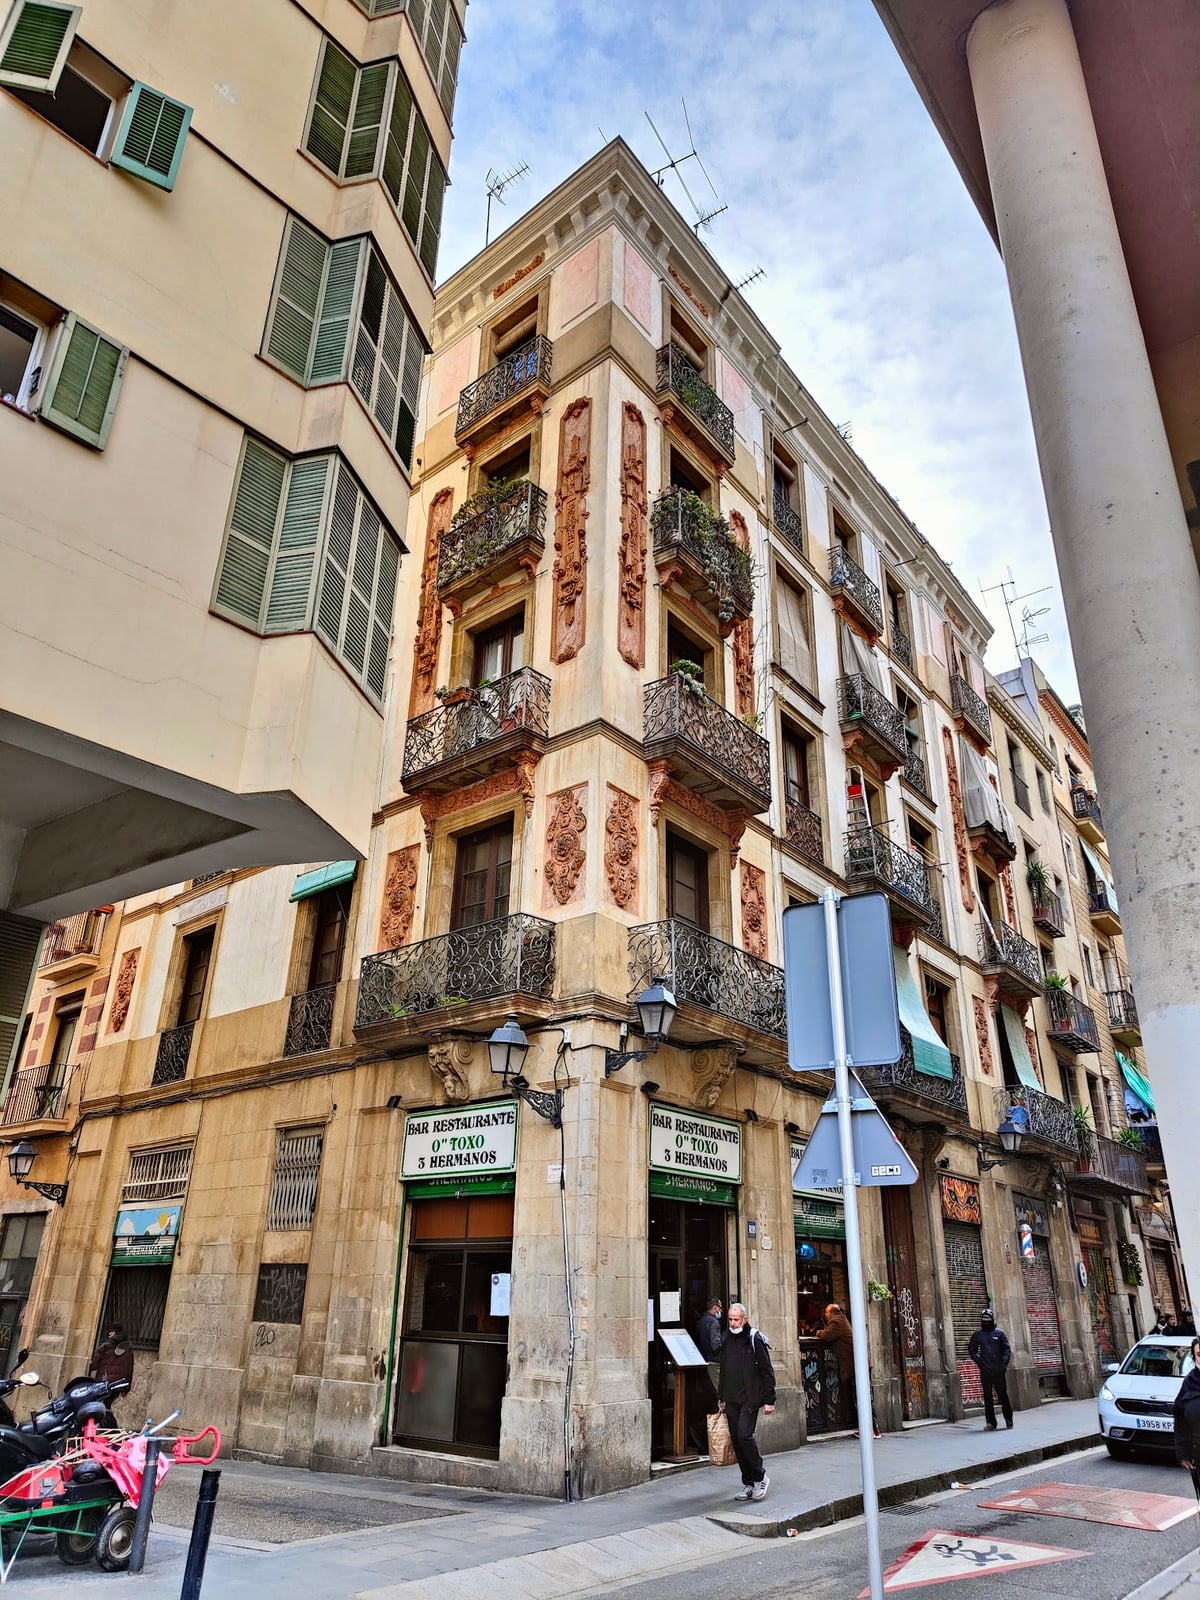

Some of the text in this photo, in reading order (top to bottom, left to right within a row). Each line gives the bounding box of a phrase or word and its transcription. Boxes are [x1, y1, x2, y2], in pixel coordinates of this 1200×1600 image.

[408, 1110, 515, 1136] BAR RESTAURANTE
[652, 1113, 739, 1144] BAR RESTAURANTE
[449, 1134, 485, 1151] TOXO
[691, 1138, 719, 1155] TOXO
[418, 1150, 497, 1170] 3 HERMANOS
[664, 1148, 728, 1172] 3 HERMANOS
[1141, 1419, 1174, 1430] 3958 KP
